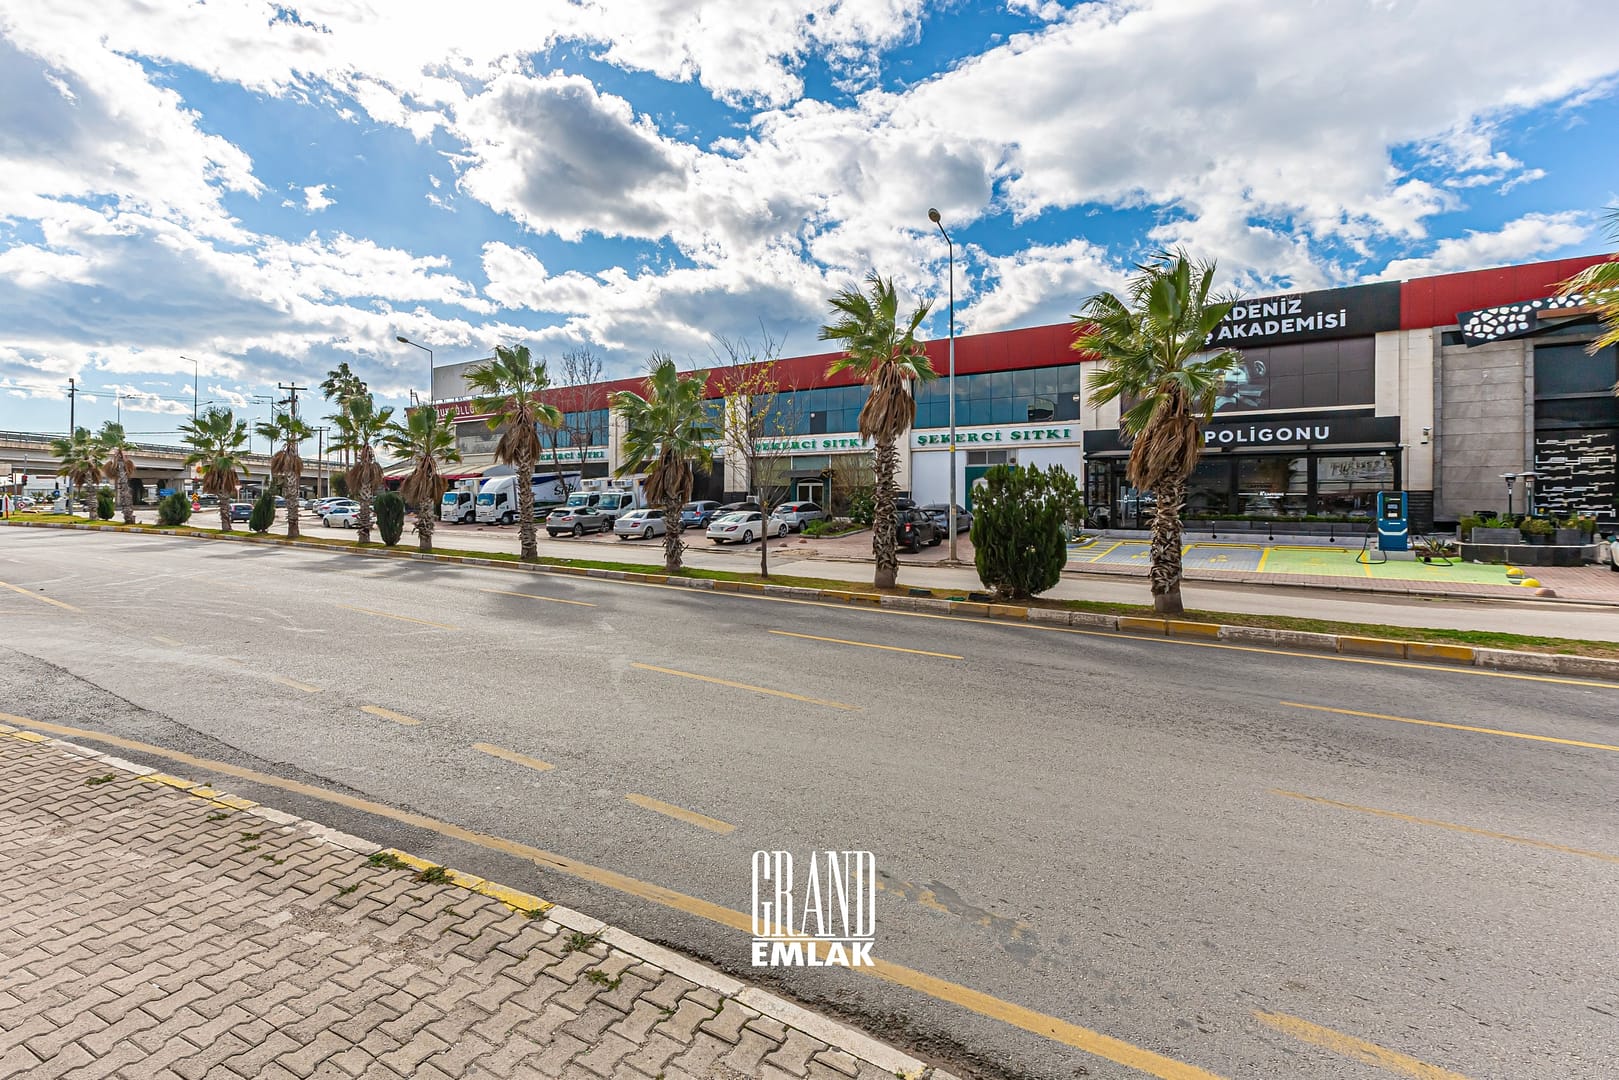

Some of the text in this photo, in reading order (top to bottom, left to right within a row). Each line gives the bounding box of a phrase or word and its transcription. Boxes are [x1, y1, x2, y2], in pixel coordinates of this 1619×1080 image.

[1220, 298, 1302, 322] DENİZ
[1217, 309, 1347, 341] AKADEMİSİ
[917, 428, 1071, 447] ŞEKERCİ SITKI
[1204, 426, 1330, 444] POLİGONU
